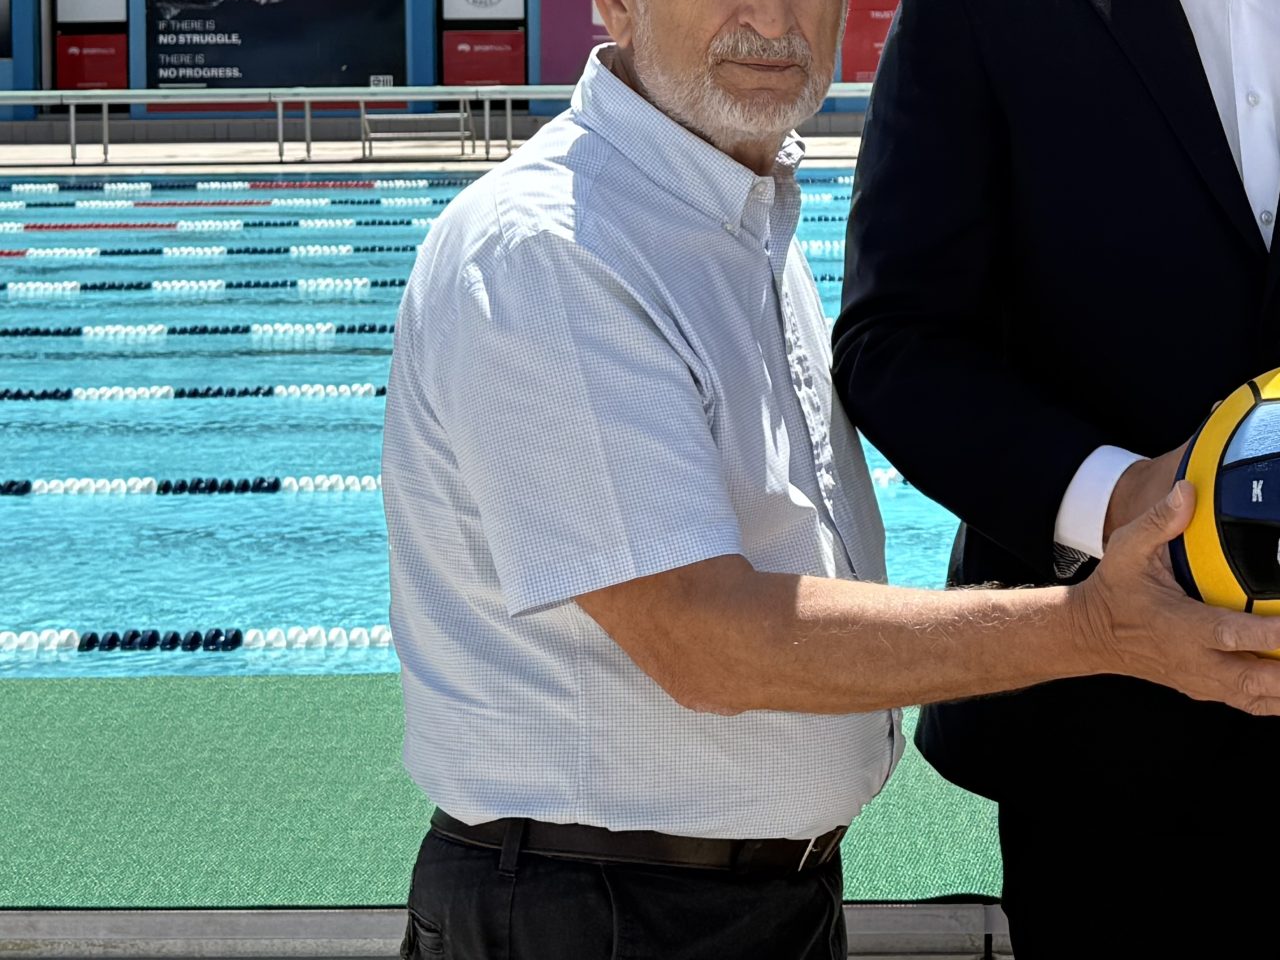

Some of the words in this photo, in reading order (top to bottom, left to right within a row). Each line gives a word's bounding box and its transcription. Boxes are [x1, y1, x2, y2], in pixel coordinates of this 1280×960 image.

[159, 20, 168, 31] IF
[170, 20, 204, 31] THERE
[206, 20, 216, 31] IS
[159, 34, 177, 45] NO
[178, 33, 242, 46] STRUGGLE,
[159, 54, 193, 65] THERE
[195, 54, 205, 65] IS
[159, 67, 177, 79] NO
